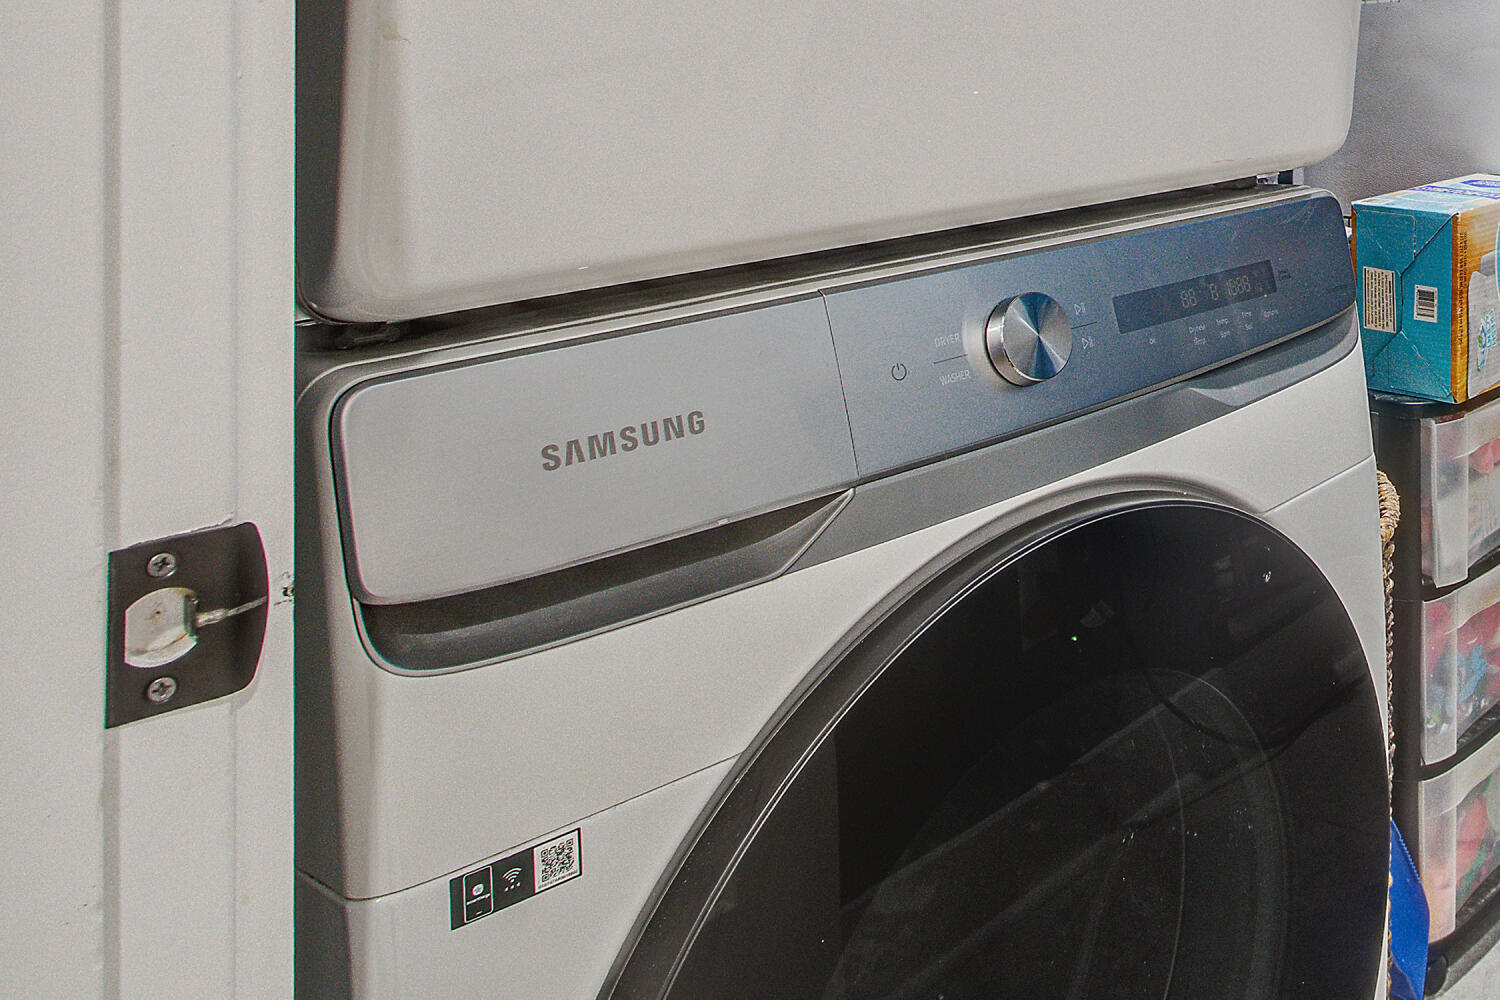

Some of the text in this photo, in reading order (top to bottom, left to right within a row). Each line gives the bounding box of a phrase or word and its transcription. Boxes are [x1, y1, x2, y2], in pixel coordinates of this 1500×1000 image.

[934, 332, 961, 349] DRYER
[939, 368, 972, 387] WASHER
[540, 409, 706, 472] SAMSUNG
